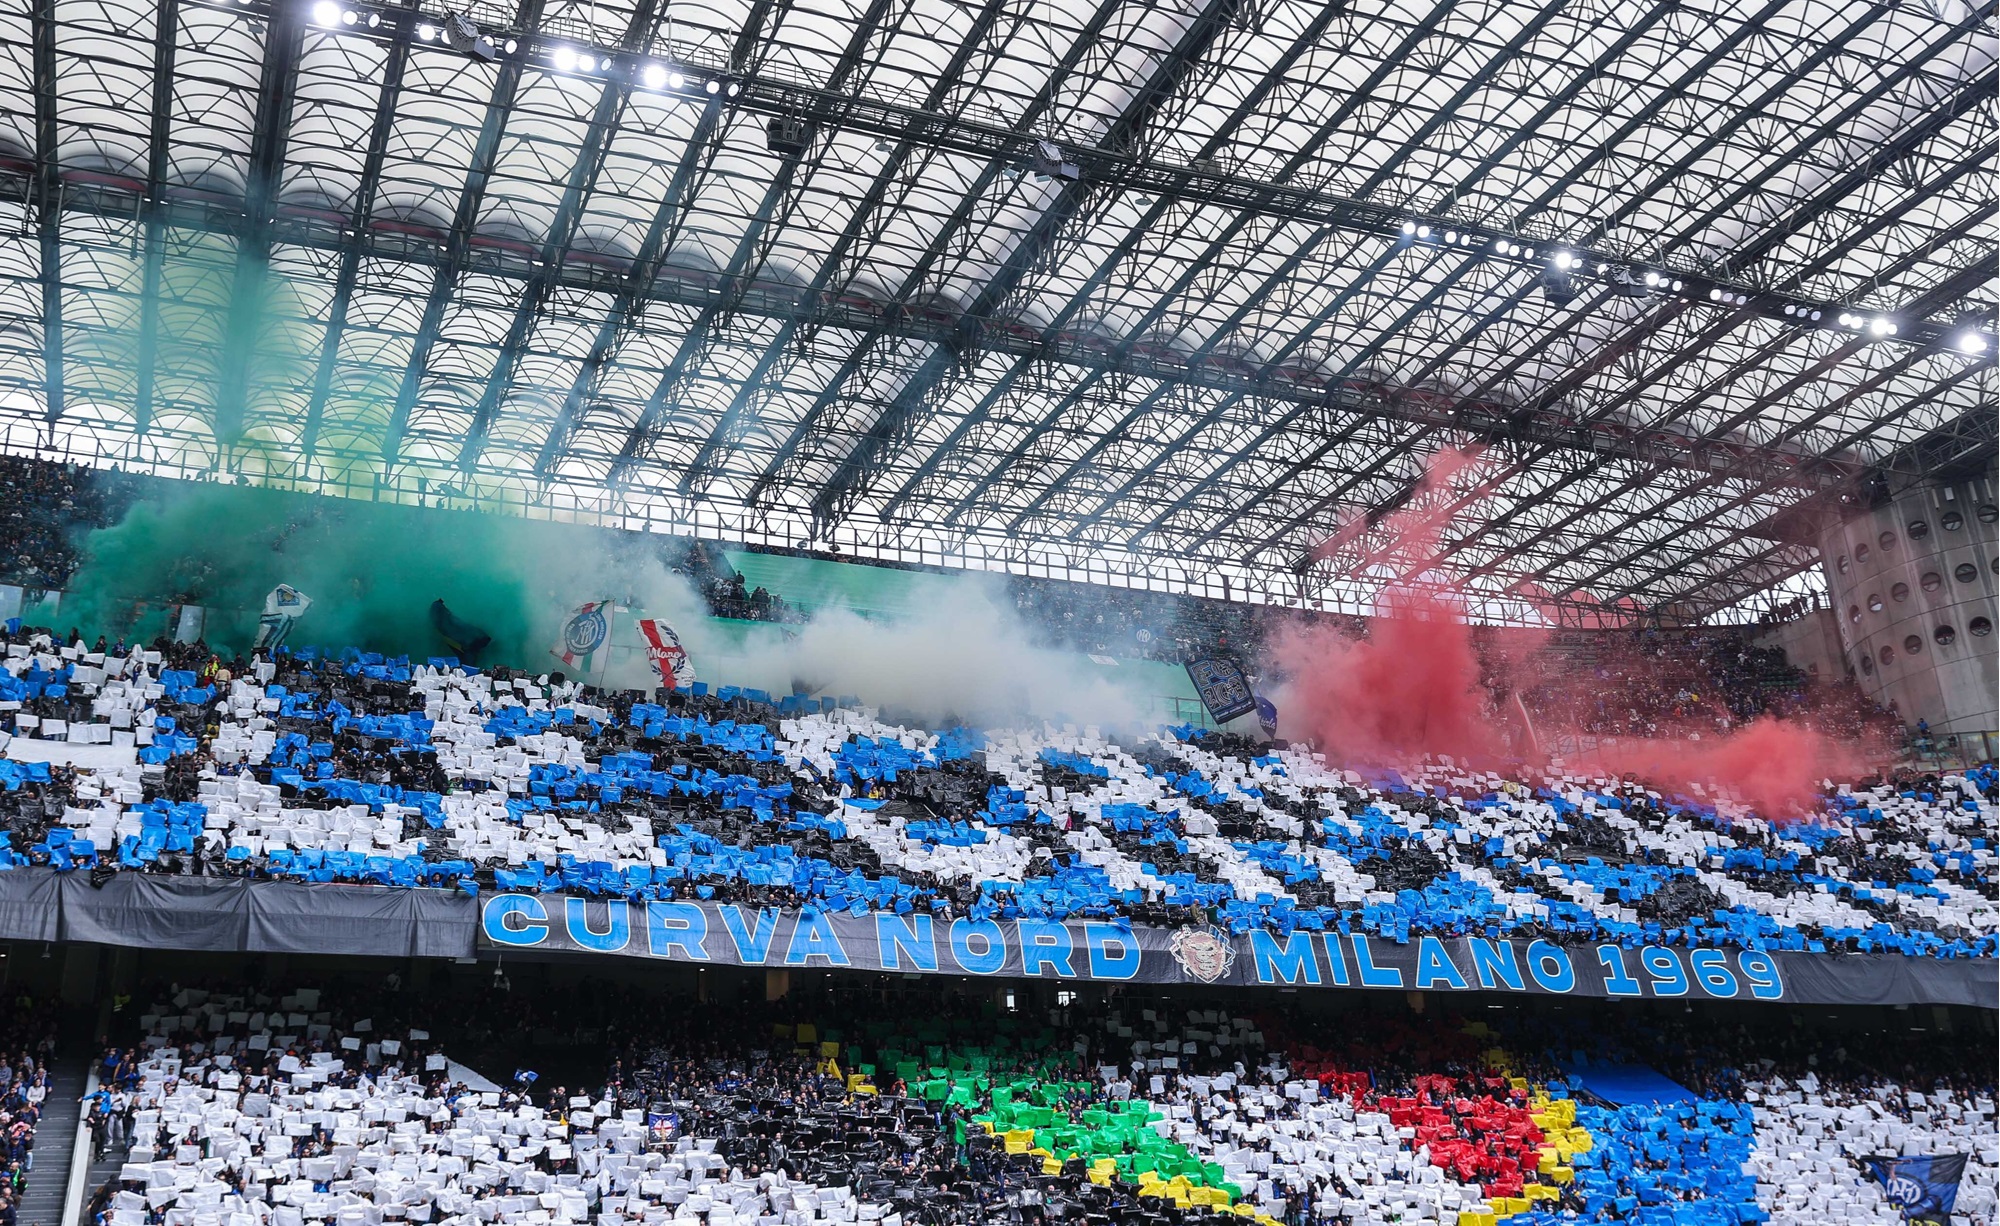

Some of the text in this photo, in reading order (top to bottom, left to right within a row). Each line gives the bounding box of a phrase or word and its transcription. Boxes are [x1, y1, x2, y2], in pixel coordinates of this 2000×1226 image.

[482, 893, 1784, 1000] CURVA NORD MILANO 1969
